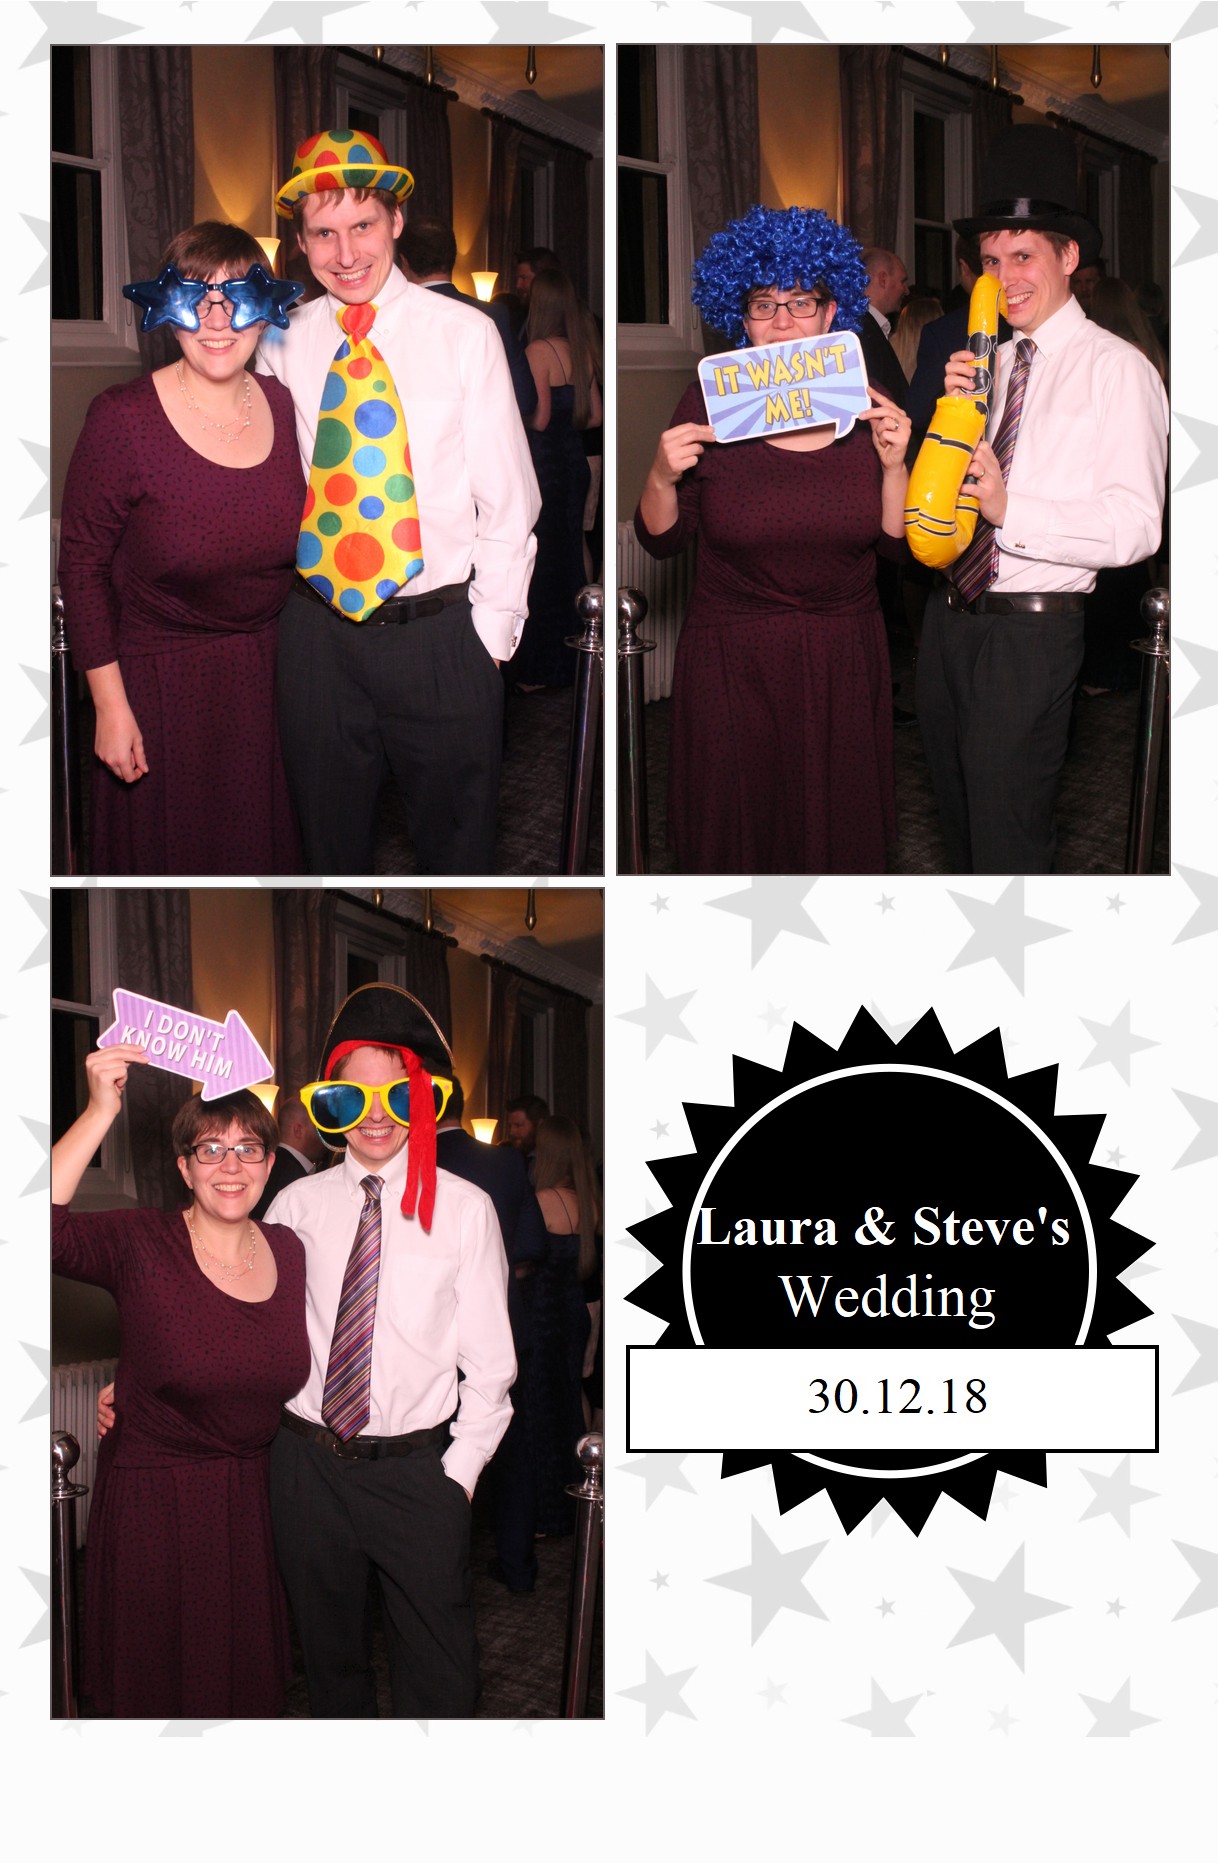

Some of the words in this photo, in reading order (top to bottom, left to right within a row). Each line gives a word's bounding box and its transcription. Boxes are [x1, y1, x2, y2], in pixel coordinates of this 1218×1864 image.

[713, 364, 740, 396] IT
[745, 344, 847, 391] WASN'T
[765, 388, 813, 425] ME!
[120, 1025, 188, 1062] KNOW
[191, 1052, 233, 1079] HIM
[144, 1010, 154, 1029] I
[157, 1014, 225, 1052] DON'T
